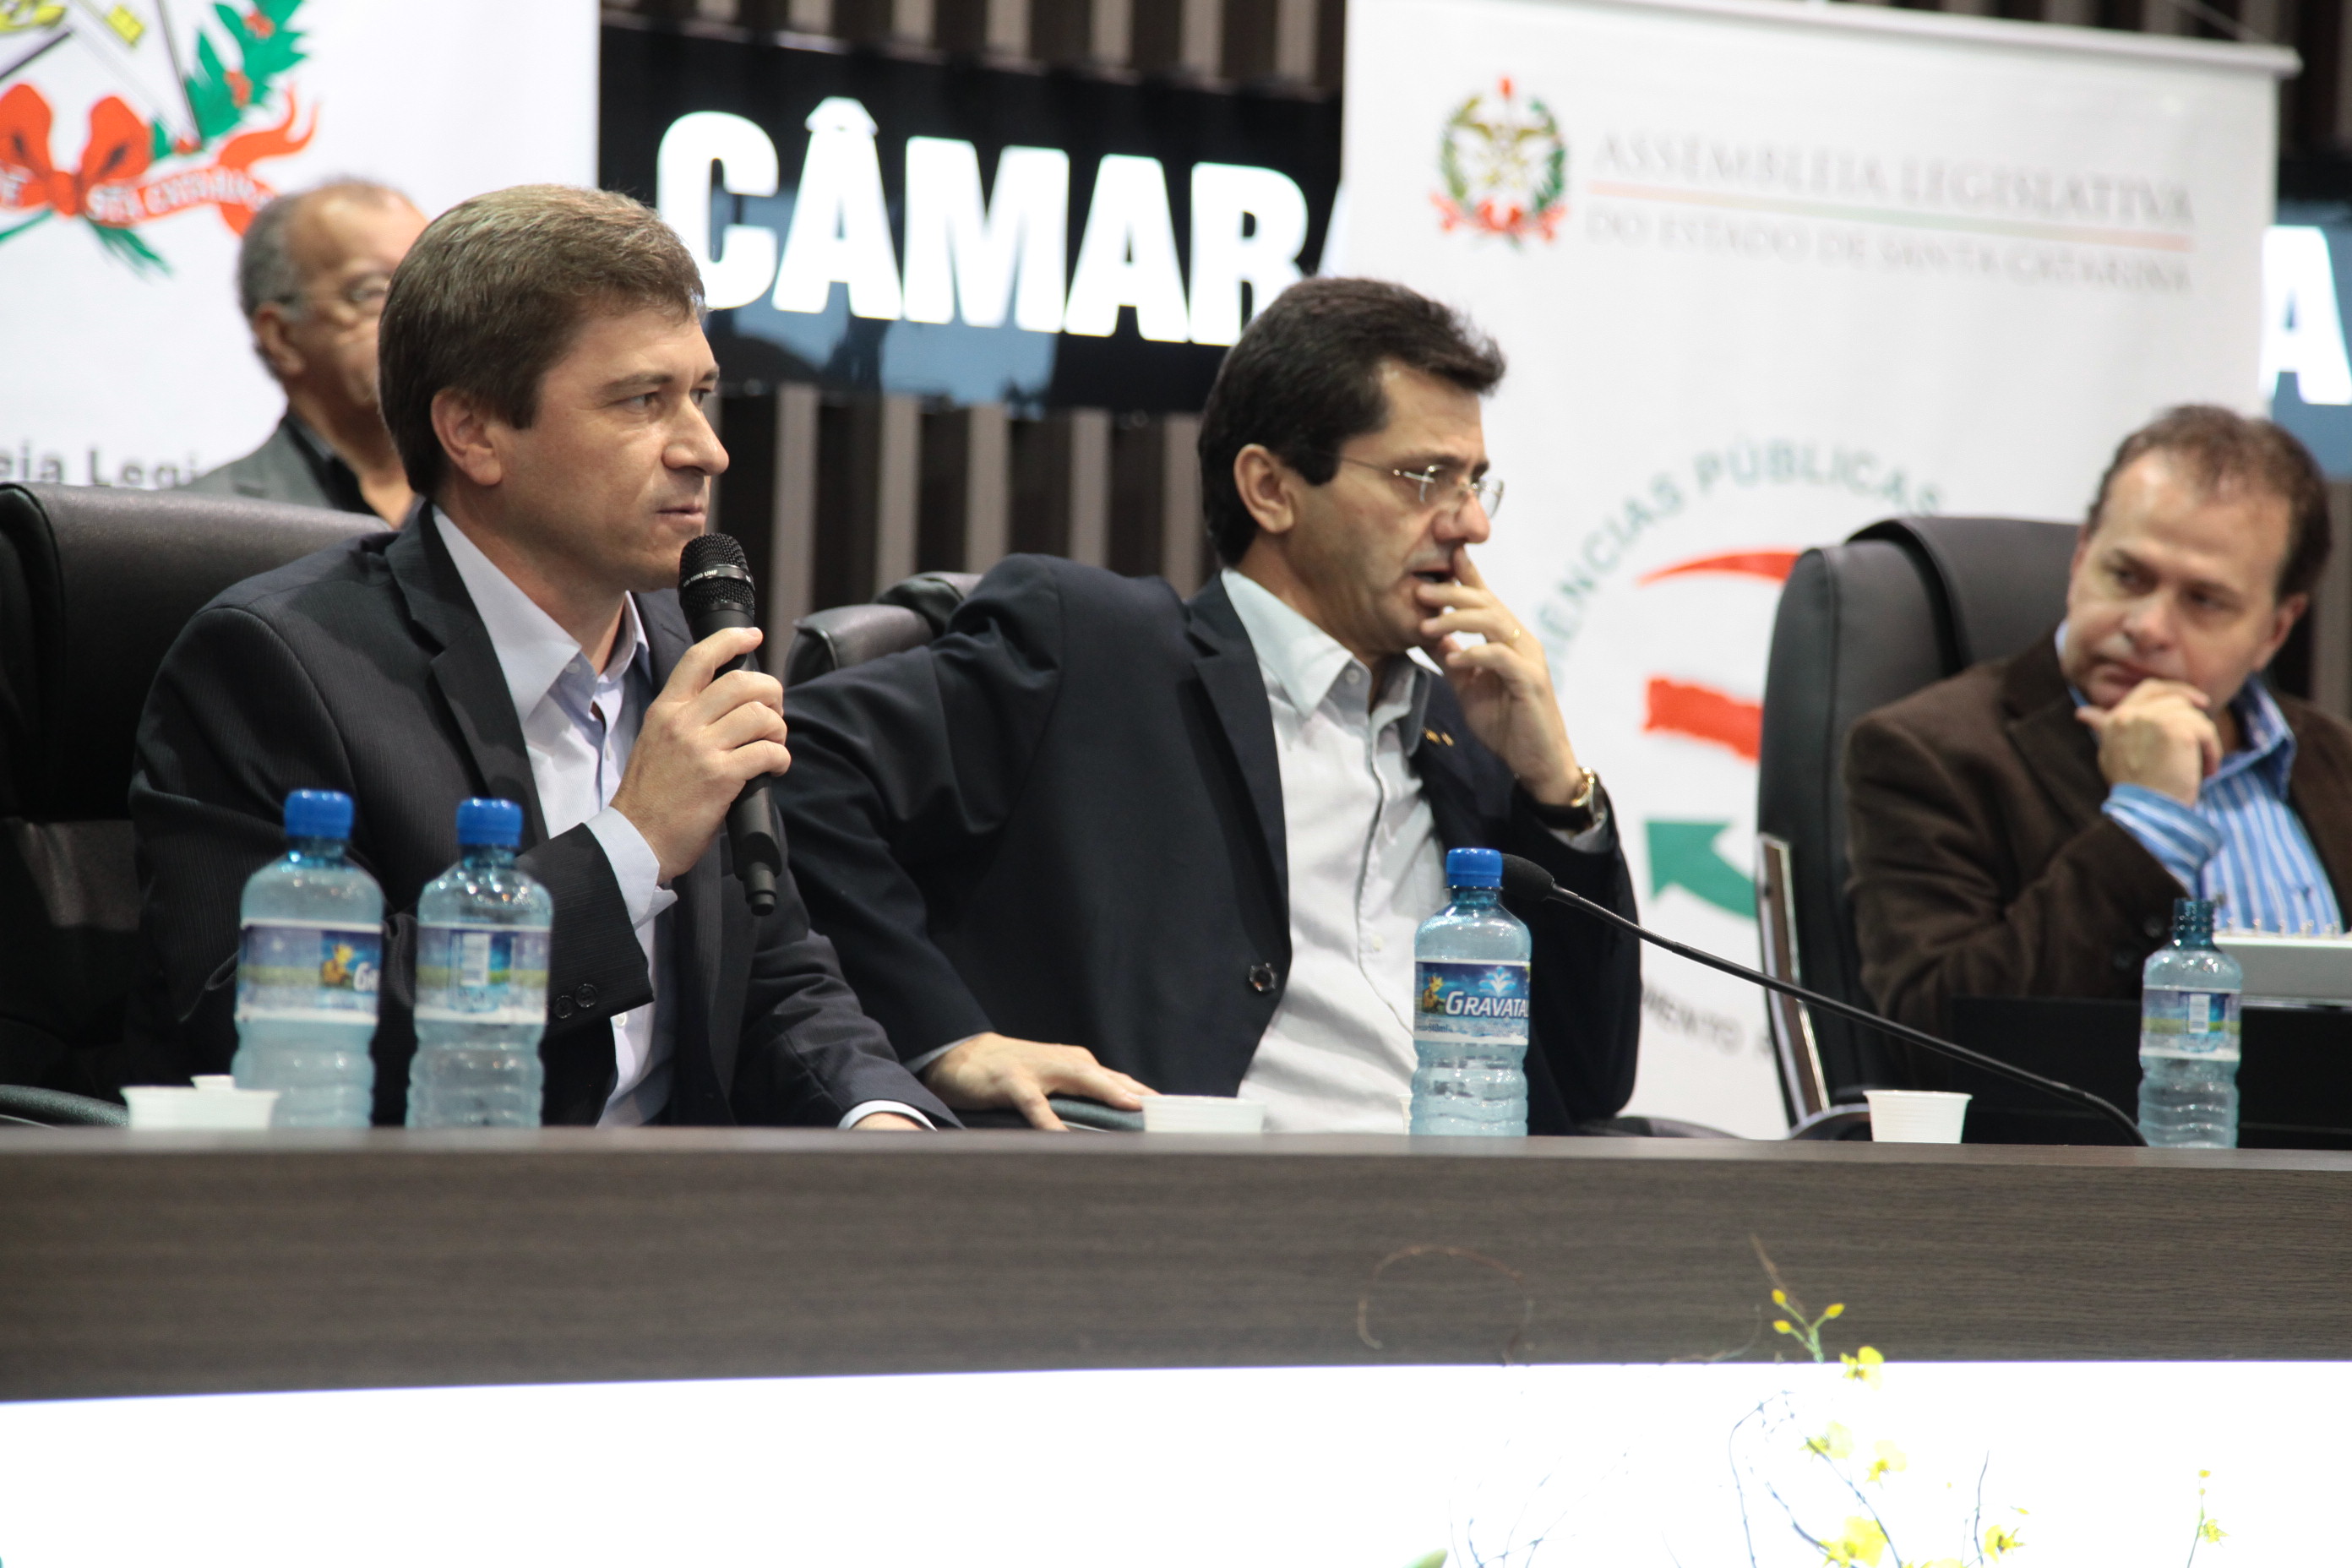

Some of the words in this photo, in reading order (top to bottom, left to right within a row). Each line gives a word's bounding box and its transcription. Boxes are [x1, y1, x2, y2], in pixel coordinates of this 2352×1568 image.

[656, 96, 1352, 347] CÂMAR
[1592, 130, 1886, 199] ASSEMBLEIA
[1900, 155, 2196, 226] LEGISLATIVA
[1586, 204, 1653, 248] DO
[1661, 208, 1811, 262] ESTADO
